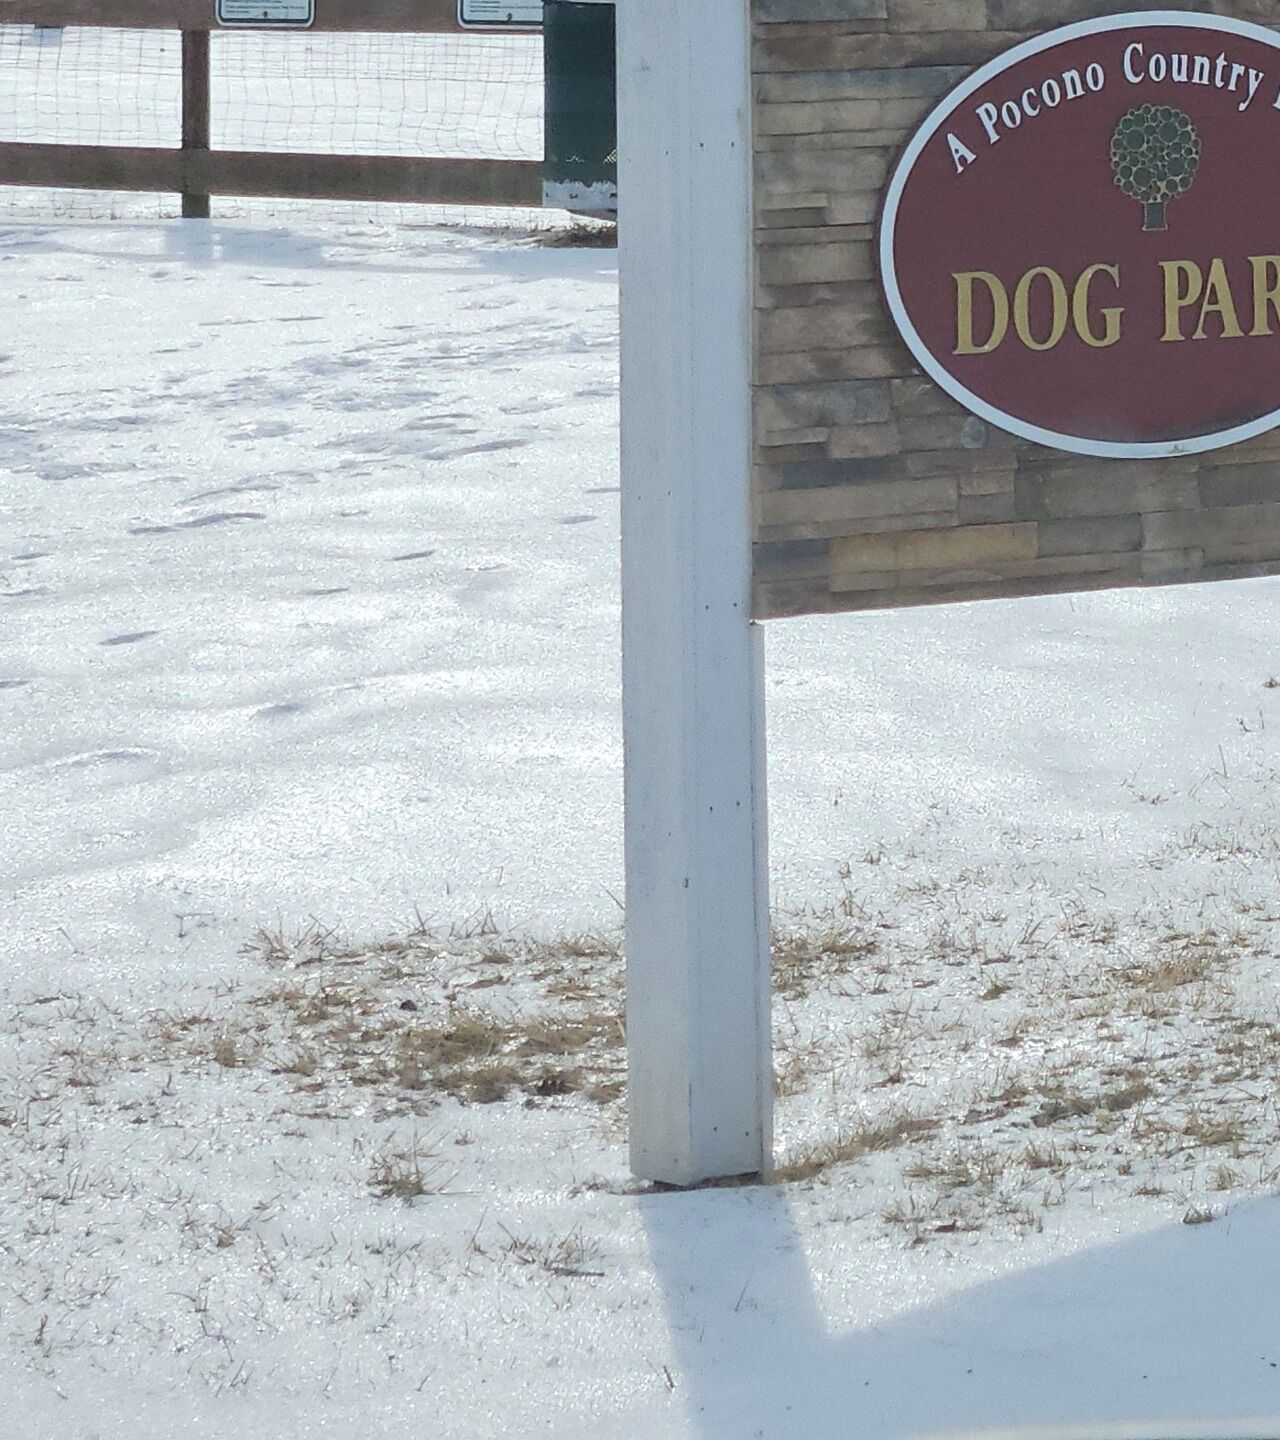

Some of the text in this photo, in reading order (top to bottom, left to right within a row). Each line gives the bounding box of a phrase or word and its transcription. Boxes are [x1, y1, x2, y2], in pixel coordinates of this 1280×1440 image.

[946, 133, 977, 174] A
[976, 62, 1106, 146] Pocono
[1123, 41, 1265, 113] Country
[951, 262, 1125, 356] DOG
